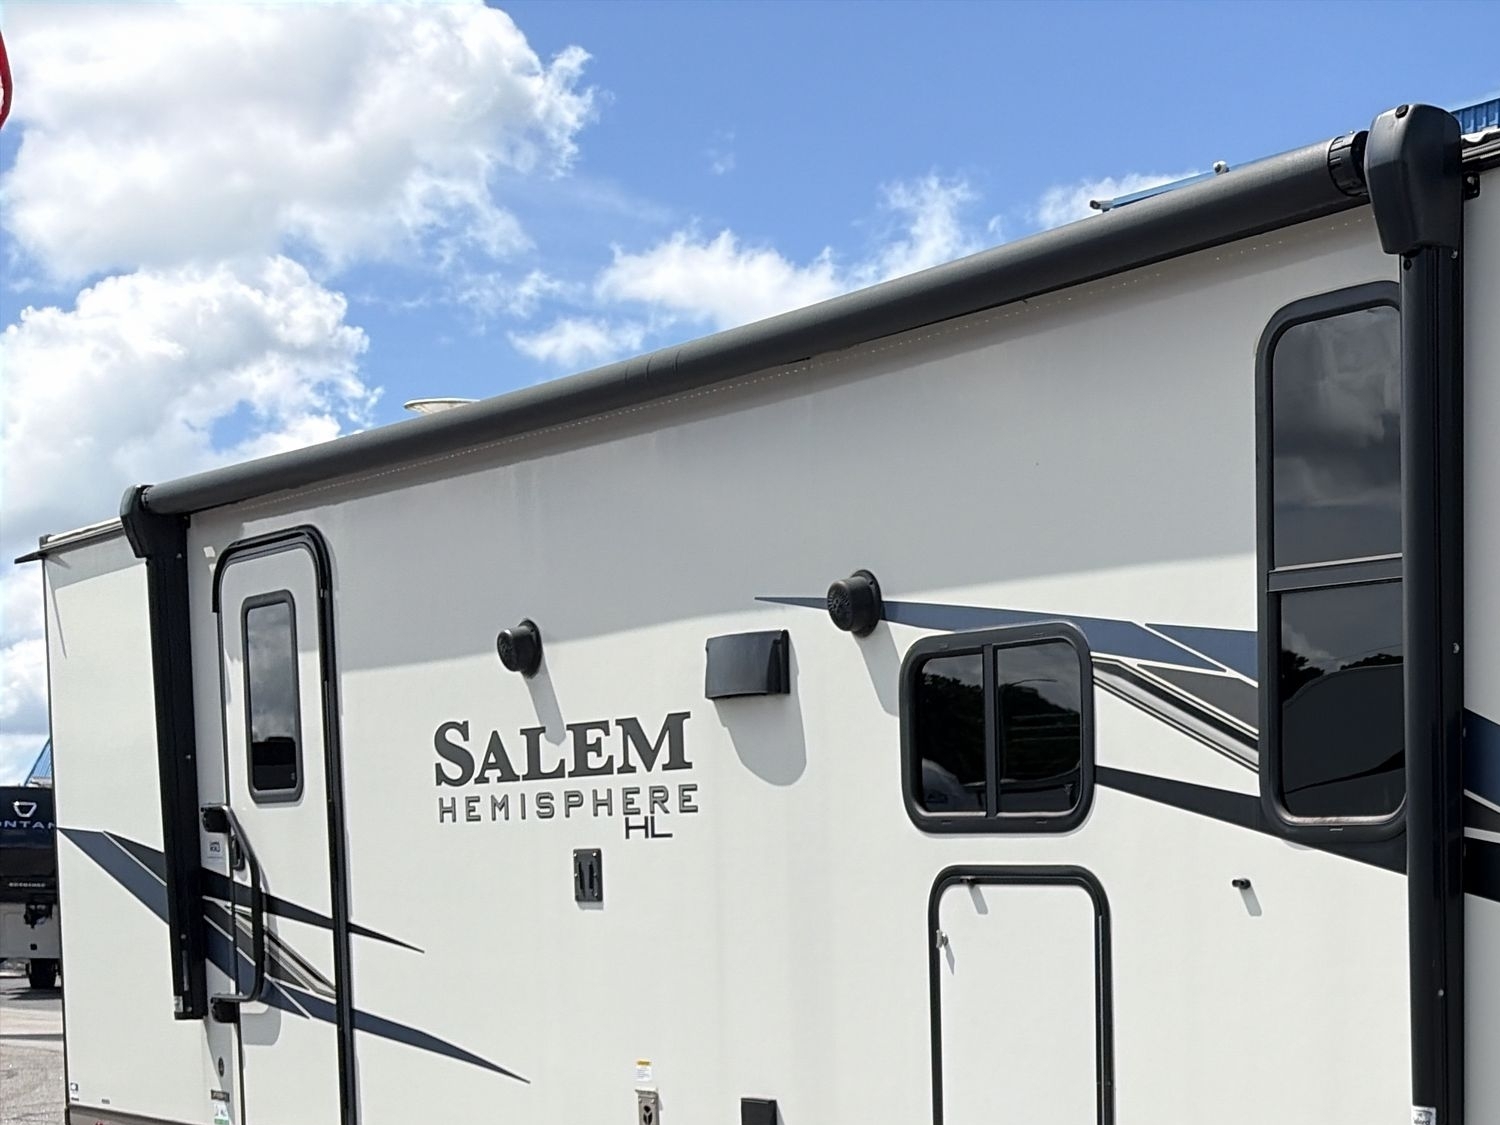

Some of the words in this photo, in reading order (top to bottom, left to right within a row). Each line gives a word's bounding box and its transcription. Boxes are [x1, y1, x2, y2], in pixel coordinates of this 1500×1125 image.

[434, 711, 693, 787] SALEM
[438, 784, 699, 823] HEMISPHERE
[625, 816, 673, 839] HL
